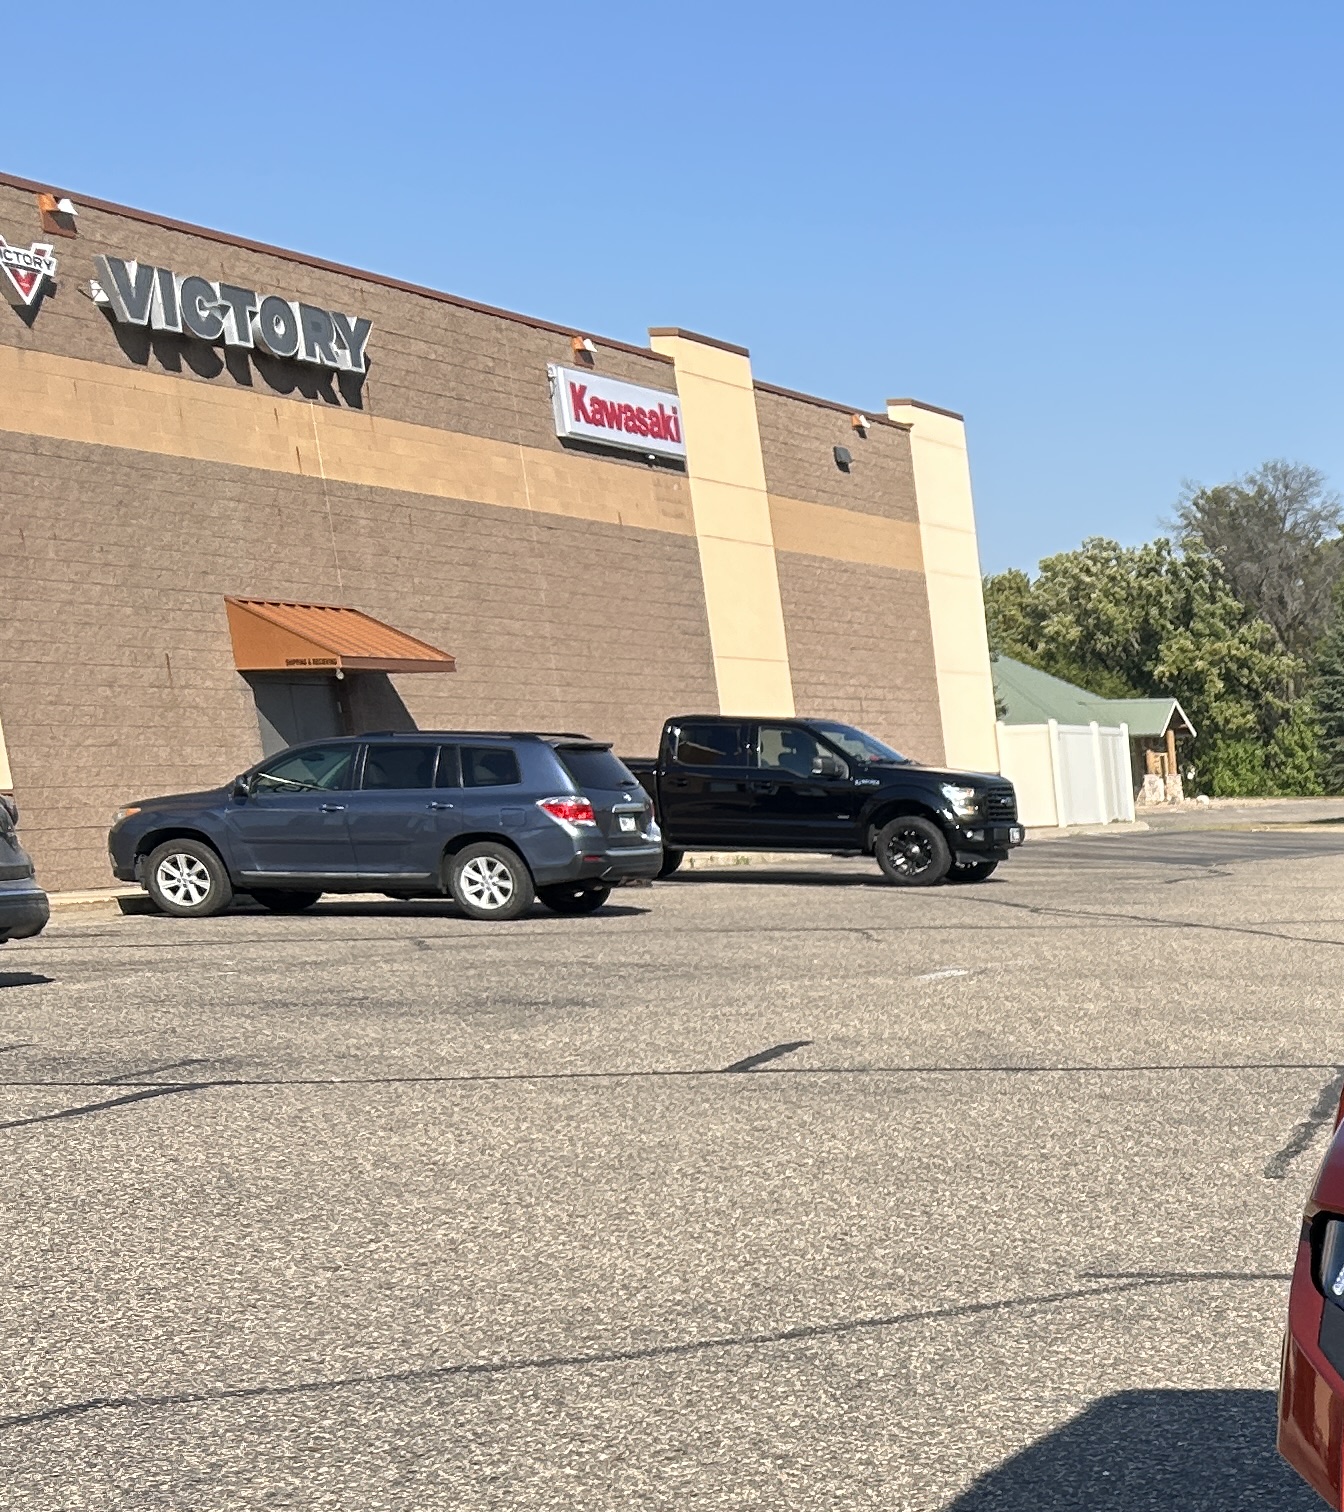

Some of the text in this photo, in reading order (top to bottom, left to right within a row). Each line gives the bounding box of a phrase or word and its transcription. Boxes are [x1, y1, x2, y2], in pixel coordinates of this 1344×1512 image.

[0, 247, 53, 271] ICTORY
[100, 254, 373, 374] VICTORY
[569, 380, 682, 444] Kawasaki
